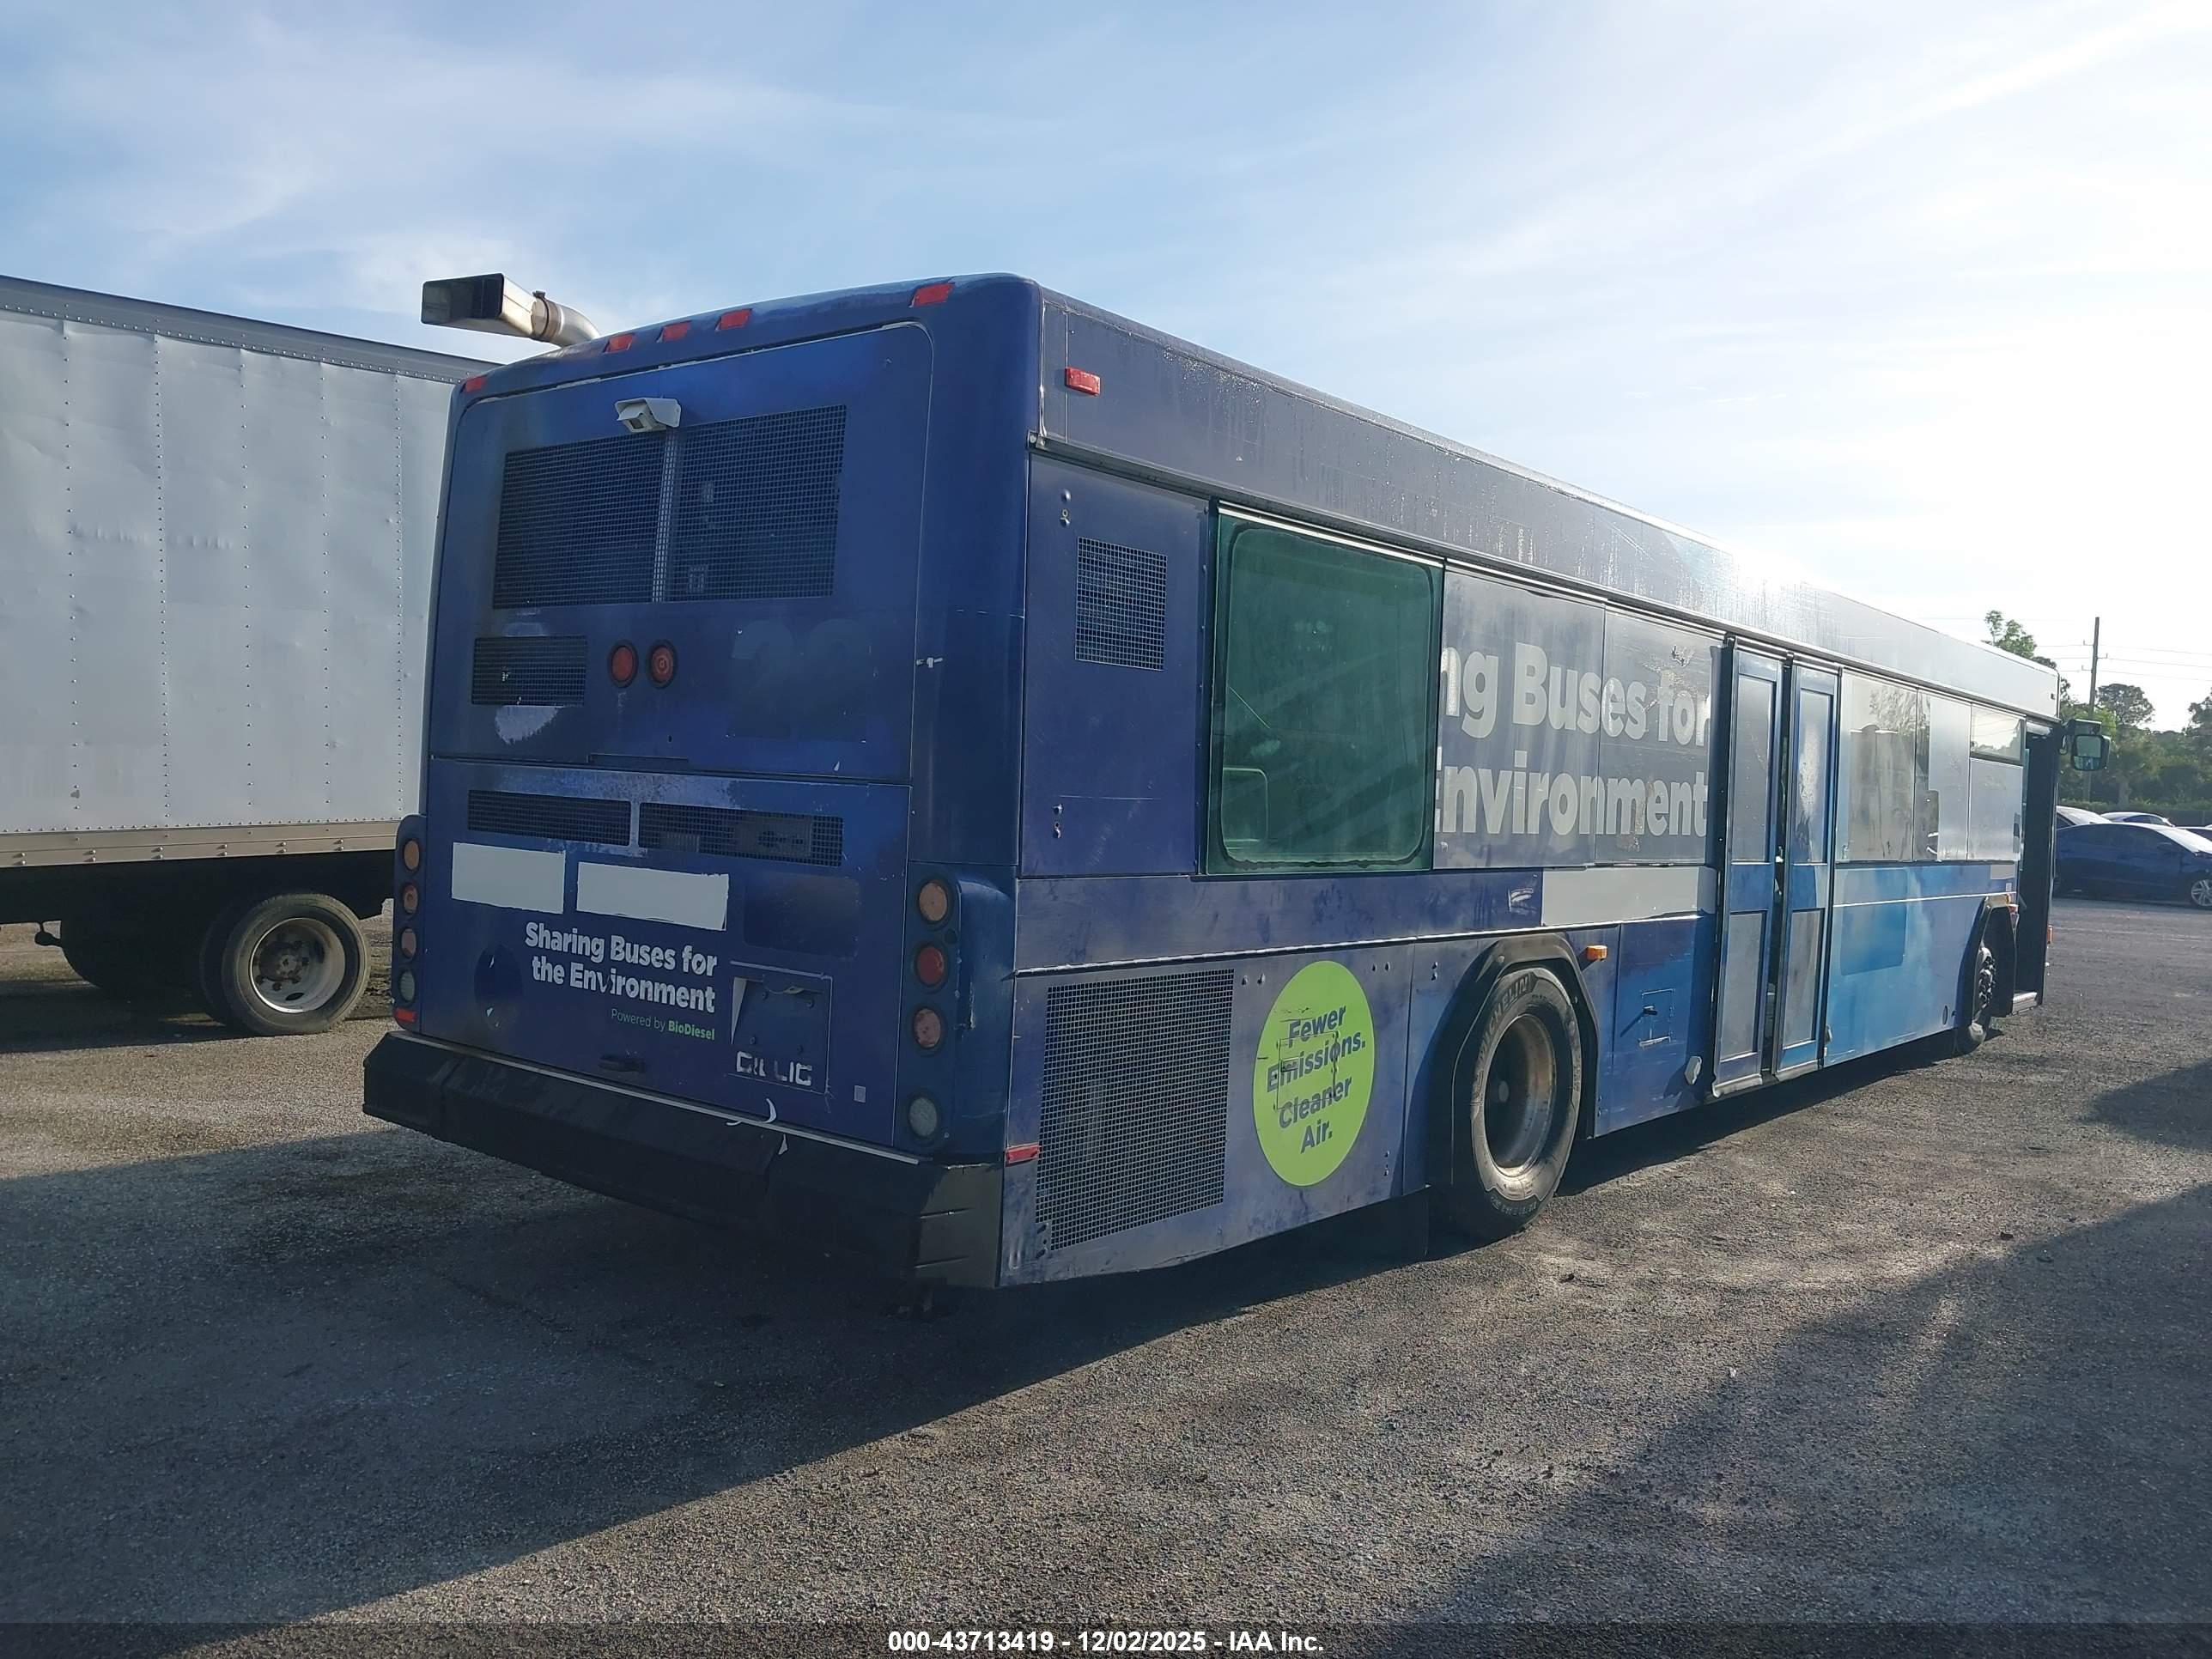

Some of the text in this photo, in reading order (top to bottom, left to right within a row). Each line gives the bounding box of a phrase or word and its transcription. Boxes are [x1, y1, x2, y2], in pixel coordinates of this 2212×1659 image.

[1512, 642, 1648, 740] Buses
[1657, 670, 1711, 746] for
[1435, 746, 1708, 836] nvironment
[525, 921, 717, 976] Sharing Buses for
[532, 956, 715, 1013] the Environment
[611, 1008, 715, 1041] Powered by BioDiesel
[1288, 1006, 1346, 1048] Fewer
[1267, 1032, 1366, 1092] Emissions.
[1279, 1077, 1352, 1128] Cleaner
[1301, 1120, 1333, 1154] Air.
